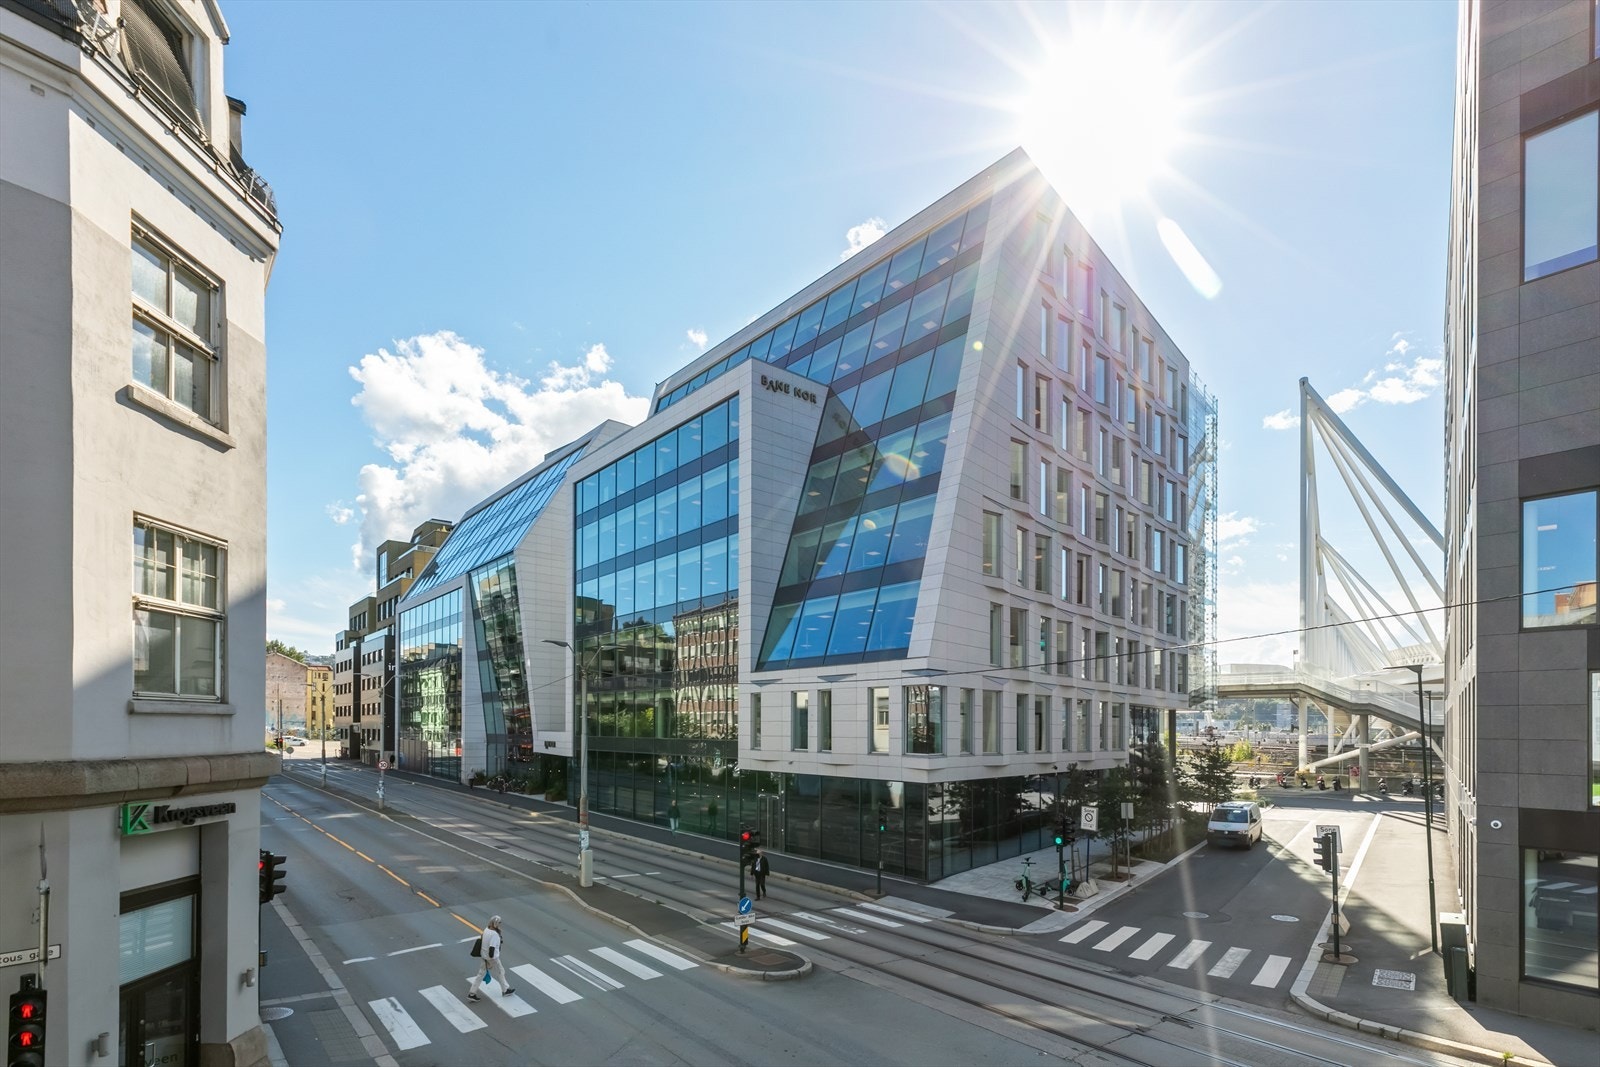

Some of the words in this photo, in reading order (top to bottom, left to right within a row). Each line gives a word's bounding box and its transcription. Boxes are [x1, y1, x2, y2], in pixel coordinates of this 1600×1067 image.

[761, 375, 790, 393] BANE
[794, 386, 816, 404] NOR
[154, 802, 236, 825] Krogsveen
[29, 949, 54, 961] ge
